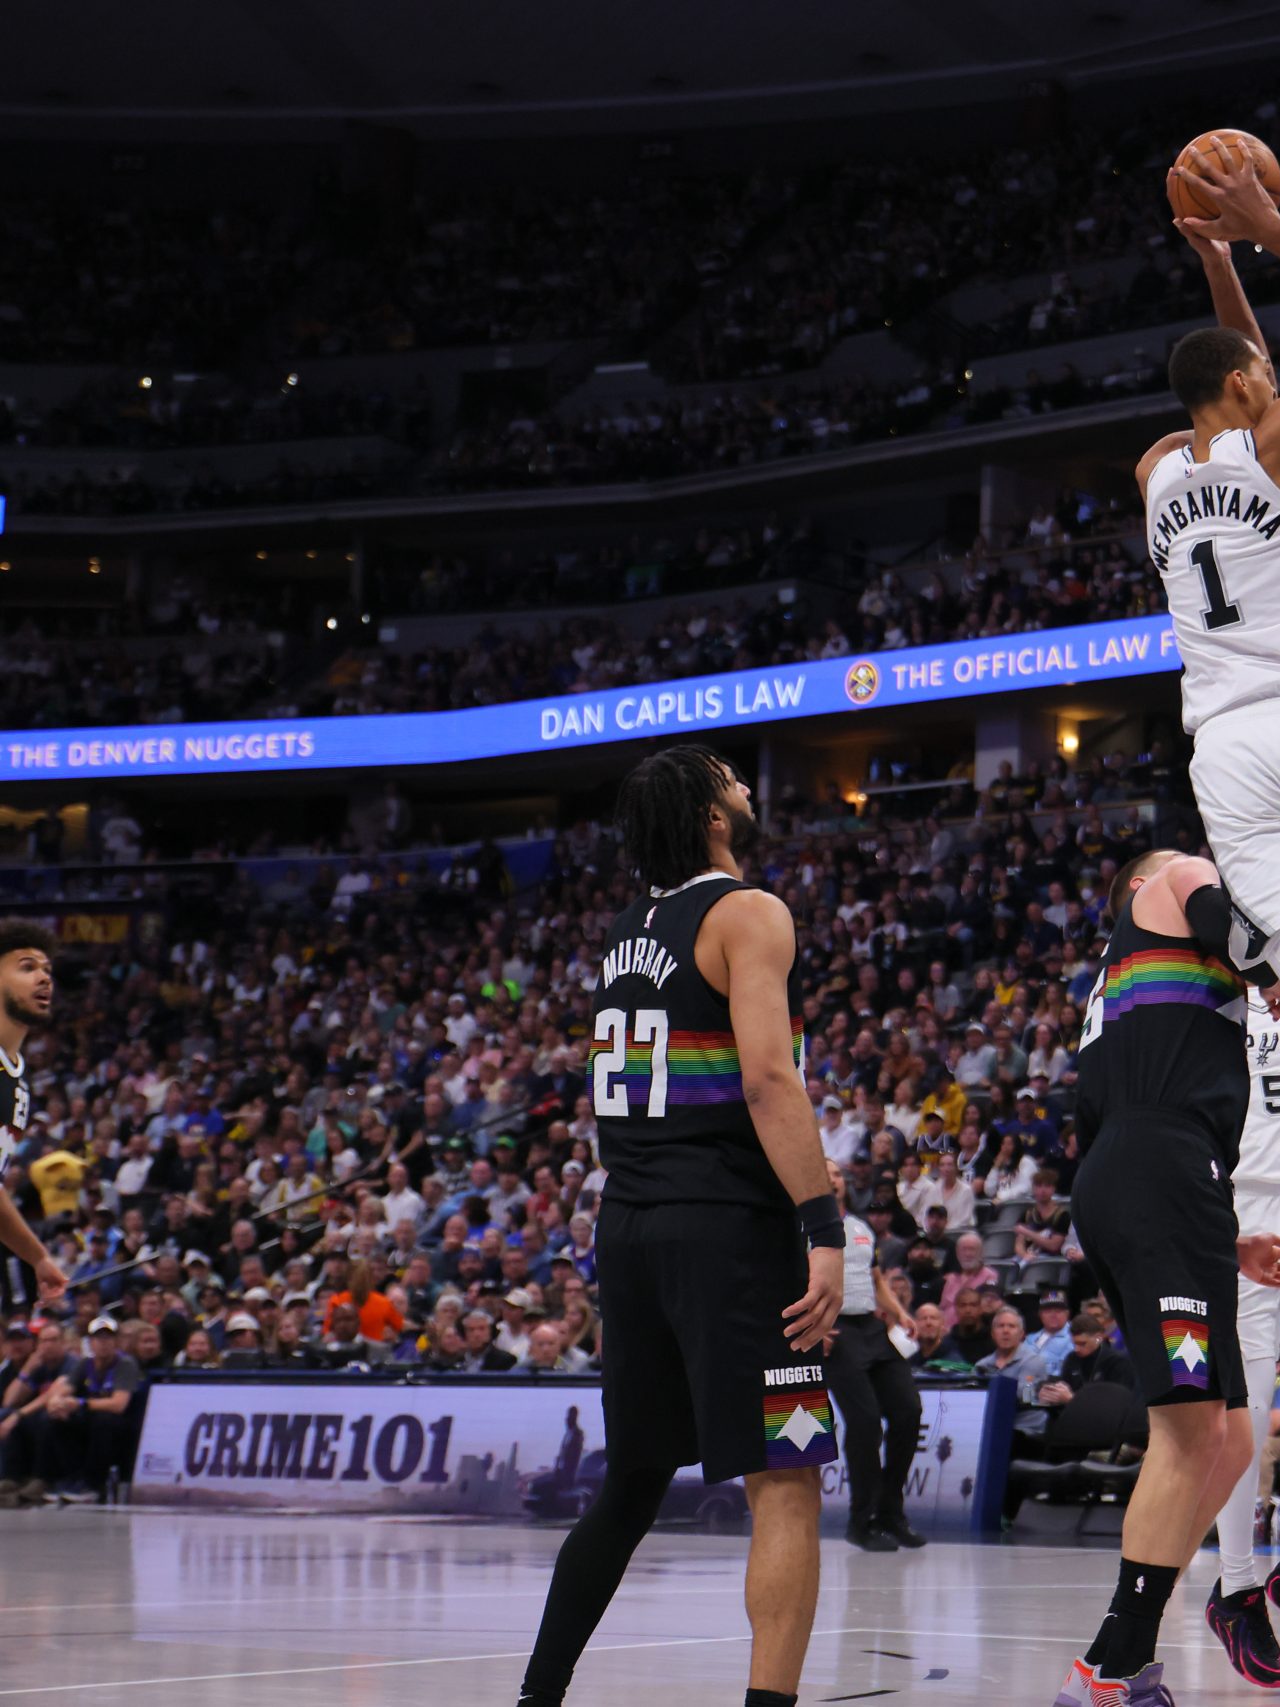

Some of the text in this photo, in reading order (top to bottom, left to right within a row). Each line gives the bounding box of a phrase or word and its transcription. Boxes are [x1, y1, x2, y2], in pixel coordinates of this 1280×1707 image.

[1190, 537, 1244, 632] 1
[890, 661, 943, 692] THE
[954, 643, 1079, 684] OFFICIAL
[1087, 634, 1149, 667] LAW
[540, 674, 806, 742] DAN CAPLIS LAW
[9, 731, 315, 768] THE DENVER NUGGETS
[603, 937, 678, 990] MURRAY
[593, 1007, 669, 1118] 27
[1159, 1297, 1207, 1316] NUGGETS
[764, 1365, 823, 1386] NUGGETS
[184, 1412, 453, 1483] CRIME 101
